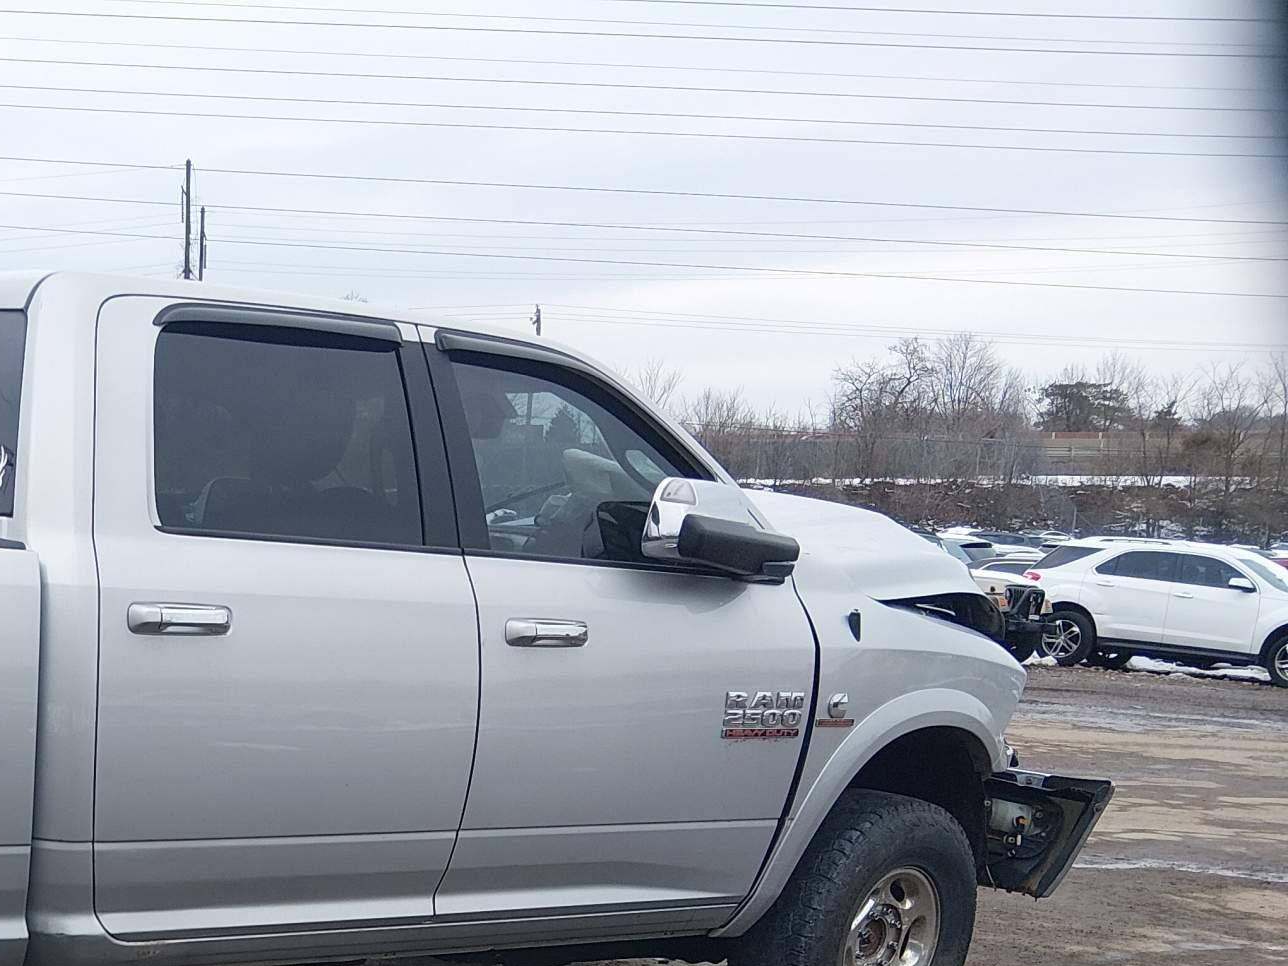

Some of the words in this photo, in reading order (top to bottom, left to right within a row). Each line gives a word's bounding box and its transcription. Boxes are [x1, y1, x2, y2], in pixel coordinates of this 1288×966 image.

[725, 691, 805, 709] RAM
[723, 709, 802, 727] 2500
[727, 729, 765, 737] HEAVY
[767, 729, 798, 737] DUTY
